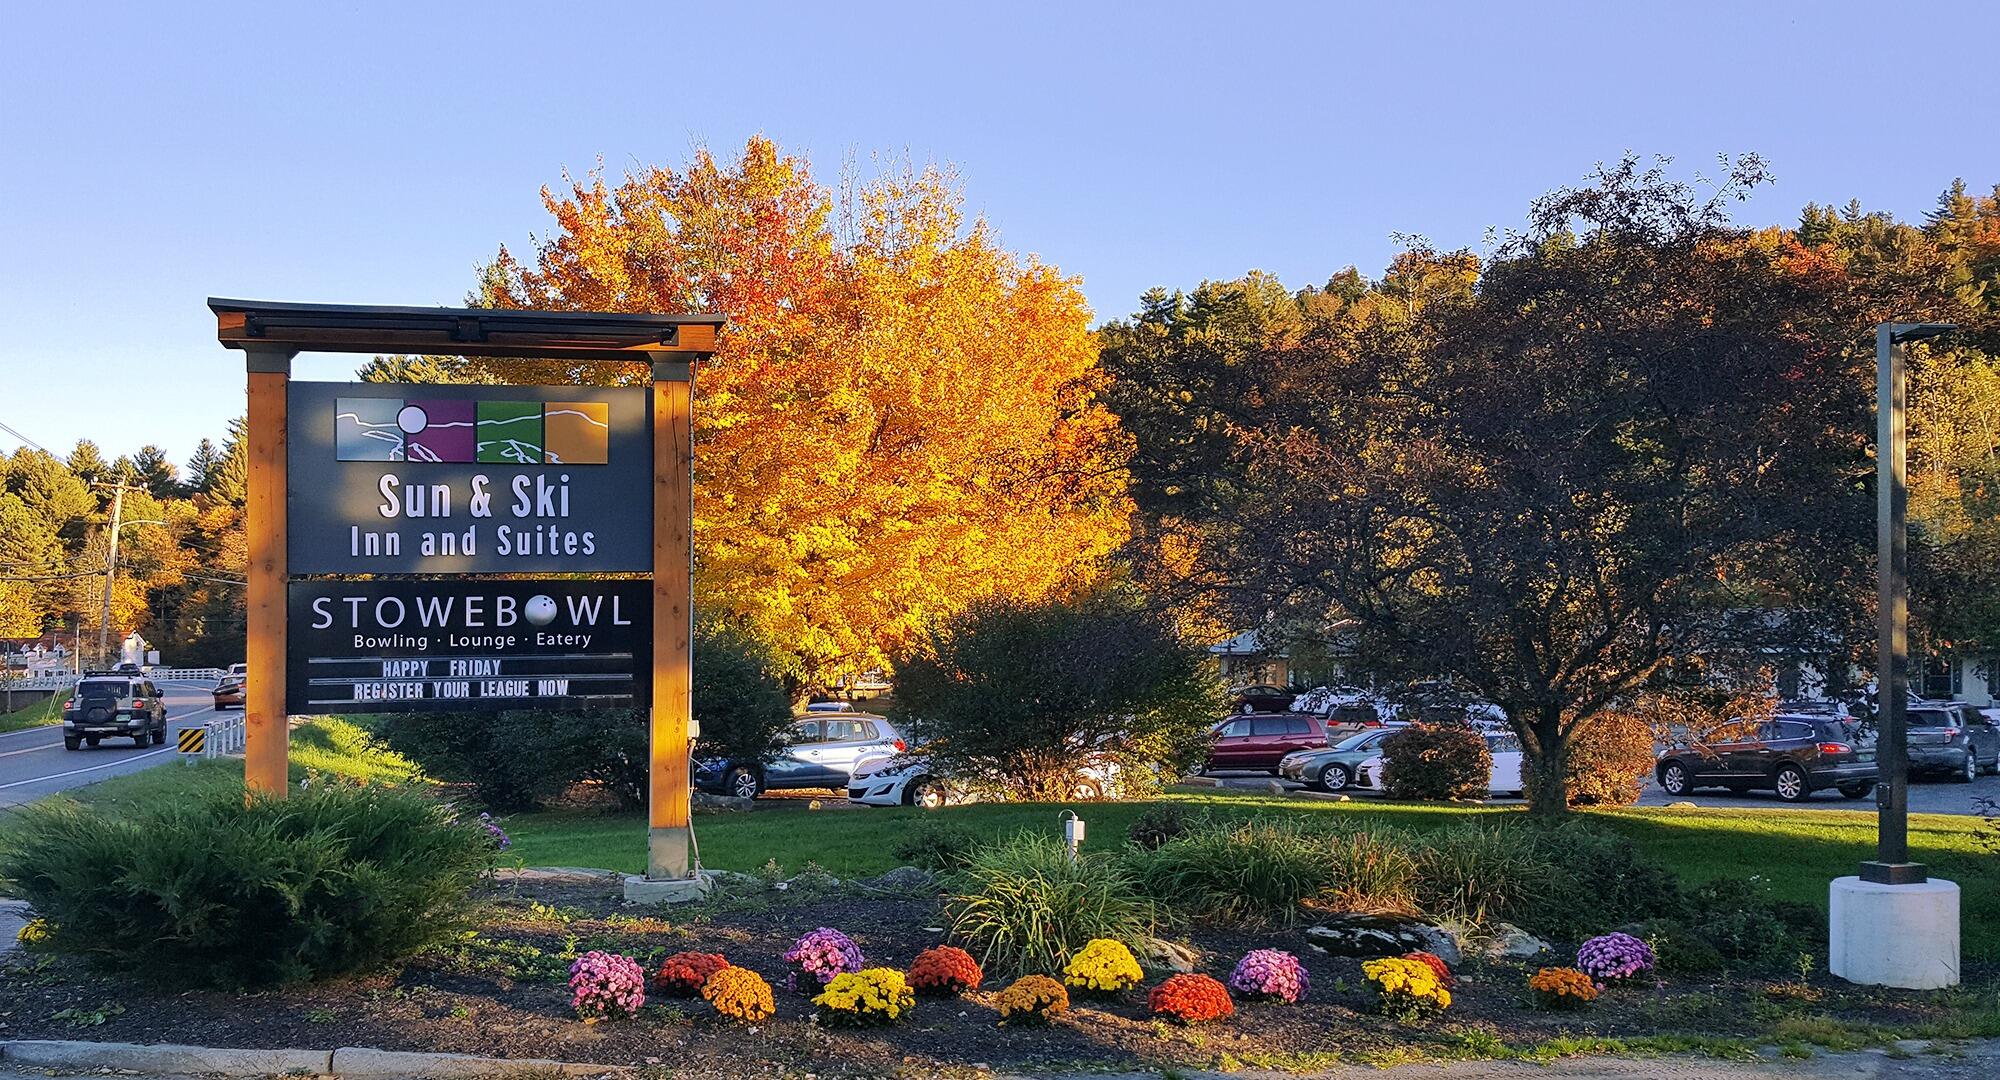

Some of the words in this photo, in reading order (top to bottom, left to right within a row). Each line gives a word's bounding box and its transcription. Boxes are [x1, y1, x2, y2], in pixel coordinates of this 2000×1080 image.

[379, 474, 451, 518] Sun
[470, 474, 492, 518] &
[512, 473, 570, 518] Ski
[351, 525, 400, 557] Inn
[421, 525, 476, 556] and
[497, 524, 596, 556] Suites
[354, 634, 428, 650] Bowling
[450, 633, 516, 650] Lounge
[536, 632, 592, 649] Eatery
[382, 660, 429, 677] HAPPY
[450, 659, 501, 676] FRIDAY
[354, 683, 423, 699] REGISTER
[433, 682, 470, 698] YOUR
[480, 680, 530, 697] LEAGUE
[538, 679, 569, 696] NOW
